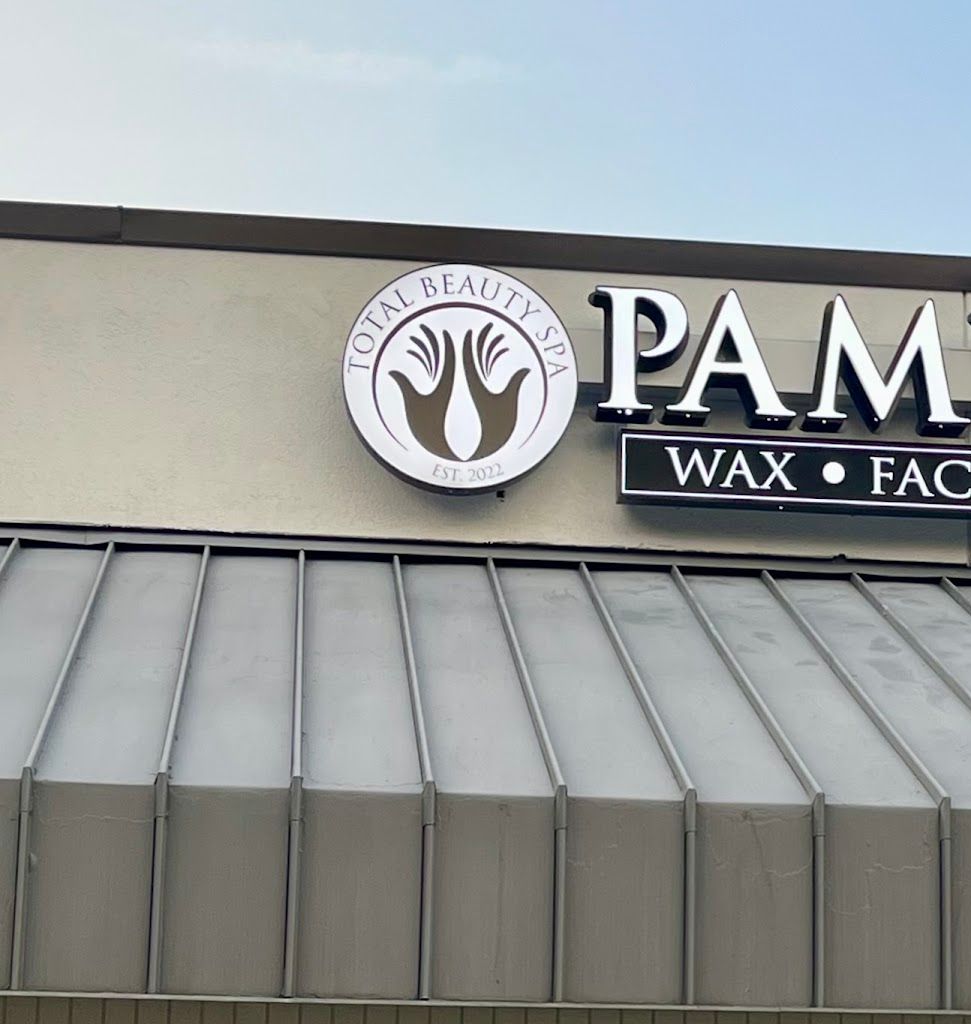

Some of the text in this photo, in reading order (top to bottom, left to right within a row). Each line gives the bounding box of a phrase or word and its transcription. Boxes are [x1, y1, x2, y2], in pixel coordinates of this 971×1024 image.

[347, 273, 569, 379] TOTAL BEAUTY SPA
[432, 463, 505, 482] EST. 2022
[665, 446, 797, 491] WAX
